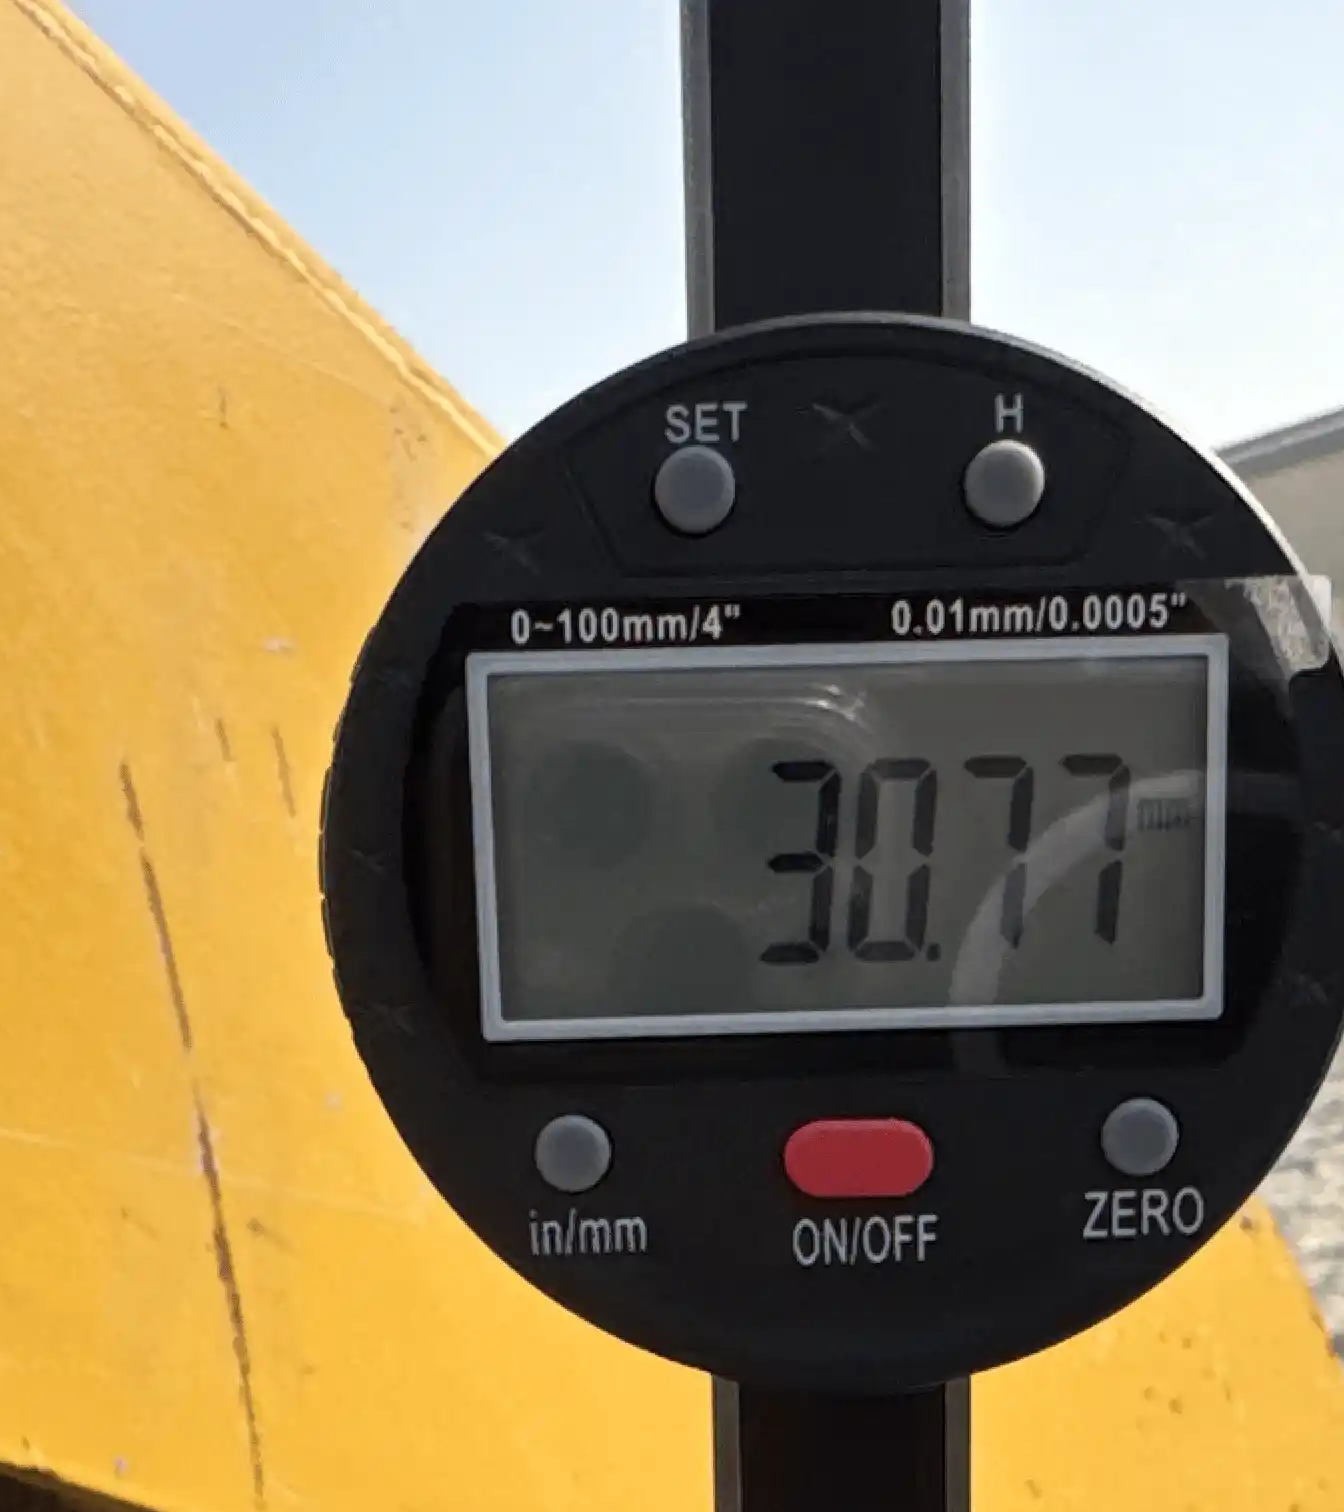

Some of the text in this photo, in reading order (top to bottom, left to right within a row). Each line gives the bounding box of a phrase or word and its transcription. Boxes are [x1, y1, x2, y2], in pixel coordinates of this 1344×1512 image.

[664, 401, 748, 443] SET
[994, 393, 1024, 434] H
[511, 603, 740, 645] 0~100mm/4"
[891, 592, 1186, 636] 0.01mm/0.0005"
[759, 753, 1131, 964] 30.77
[529, 1209, 648, 1257] in/mm
[1082, 1187, 1204, 1240] ZERO
[792, 1214, 939, 1266] ON/OFF
